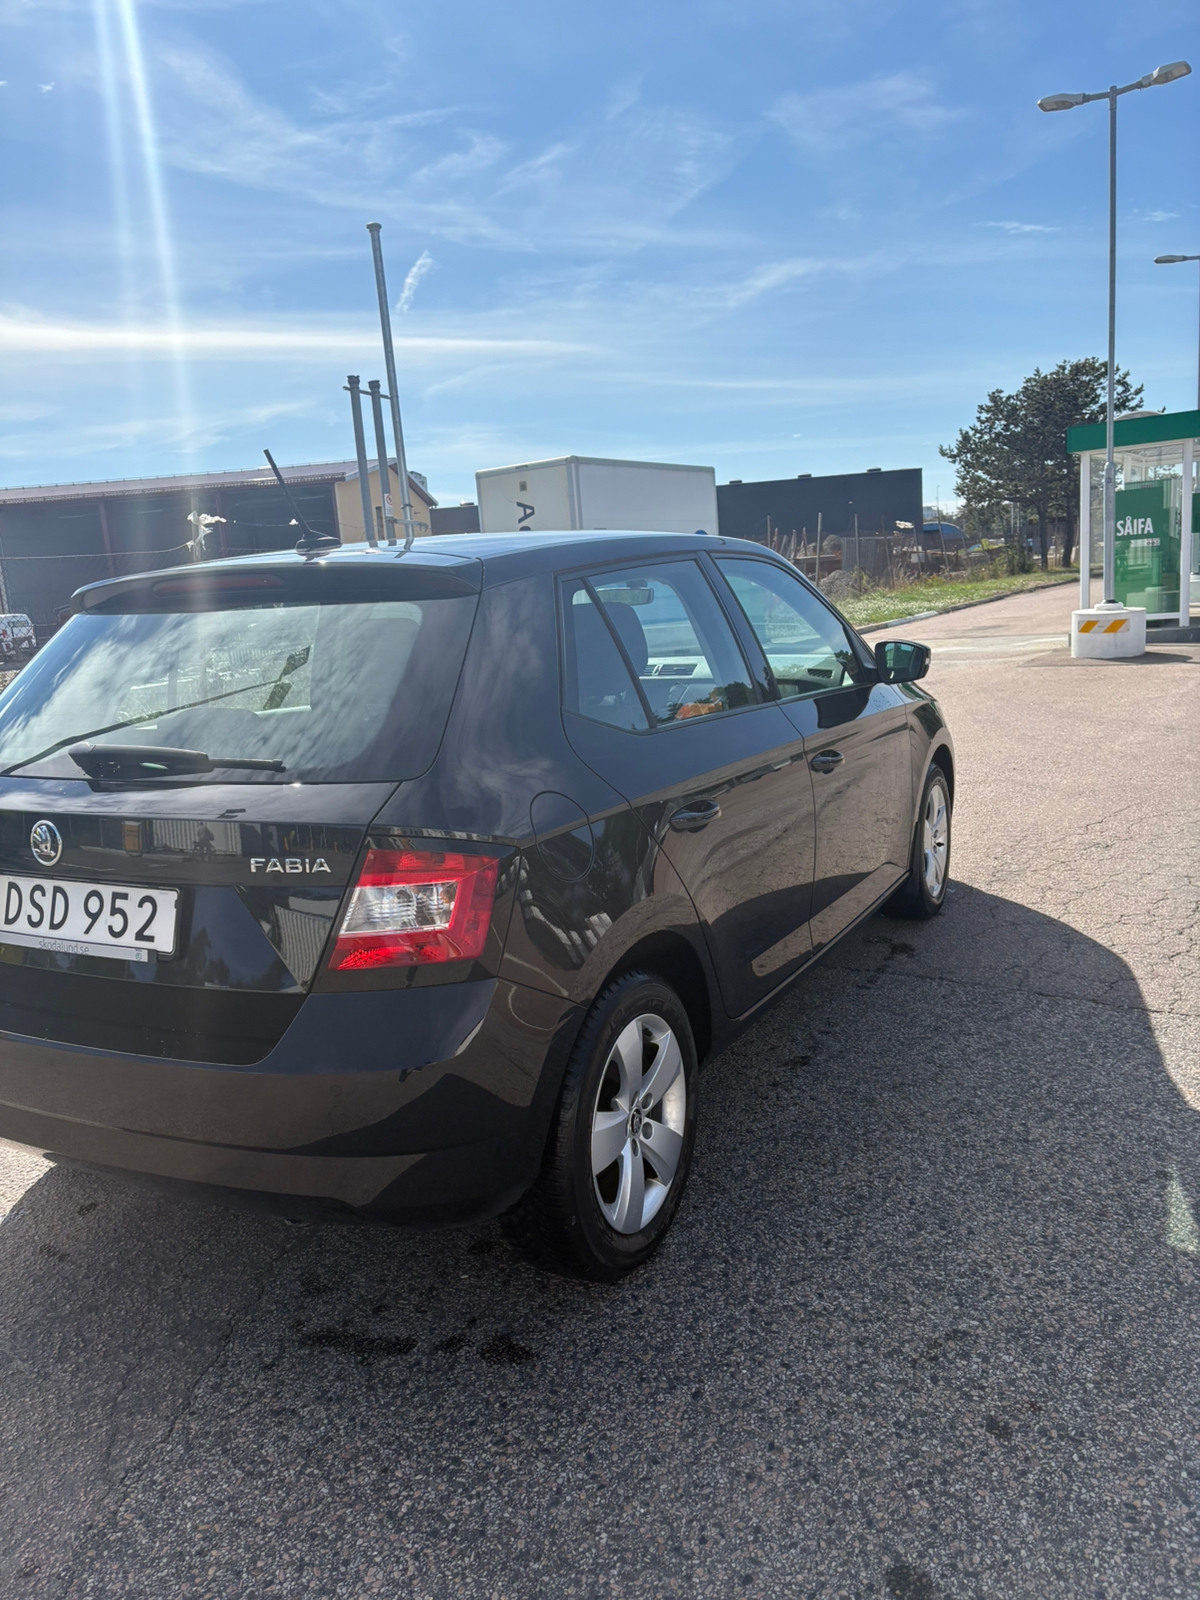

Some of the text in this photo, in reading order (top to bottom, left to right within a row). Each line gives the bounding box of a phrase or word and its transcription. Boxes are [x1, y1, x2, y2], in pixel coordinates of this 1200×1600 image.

[1116, 515, 1154, 537] SÅIFA
[250, 857, 332, 874] FABIA
[4, 881, 158, 943] DSD 952
